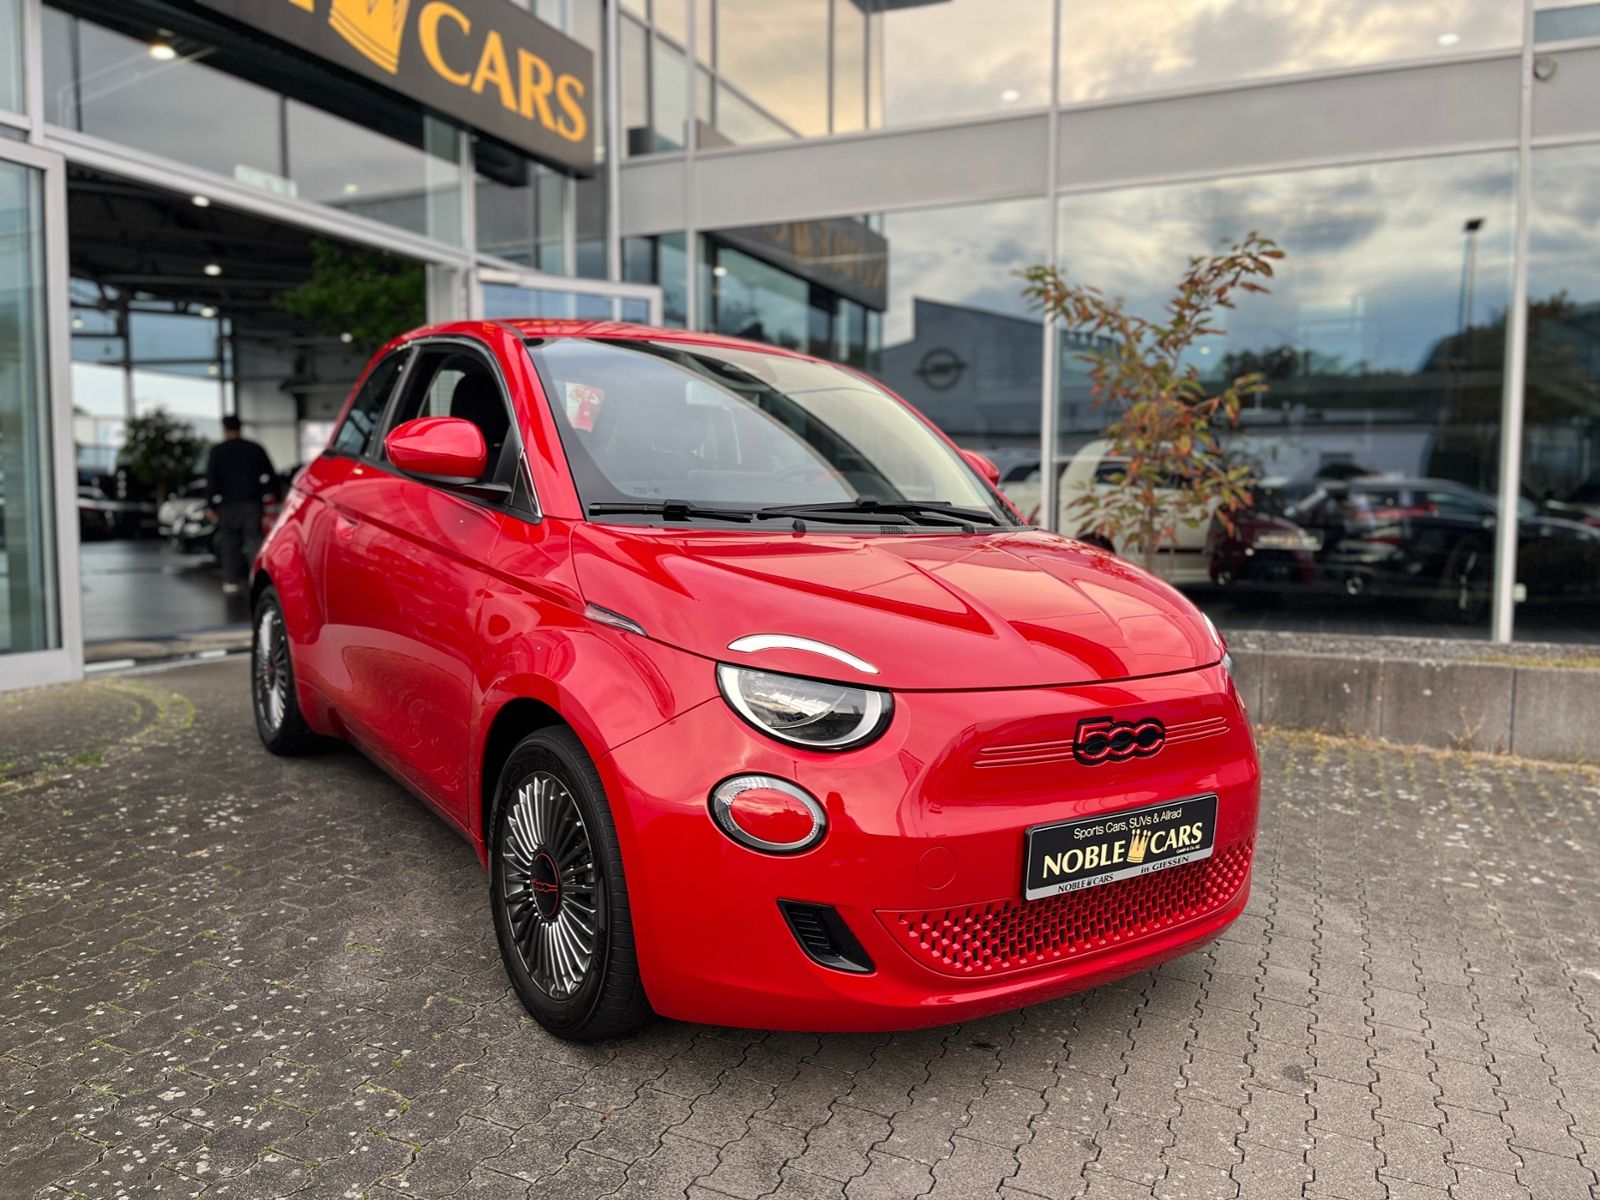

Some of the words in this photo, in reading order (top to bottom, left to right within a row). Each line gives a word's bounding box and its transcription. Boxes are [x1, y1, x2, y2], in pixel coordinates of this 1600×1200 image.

[418, 2, 587, 142] CARS
[1073, 716, 1166, 767] 500
[1074, 825, 1104, 840] Sports
[1105, 820, 1128, 834] Cars,
[1129, 815, 1152, 829] SUVs
[1153, 812, 1160, 824] &
[1160, 808, 1182, 822] Allrad
[1042, 840, 1126, 878] NOBLE
[1150, 822, 1203, 854] CARS
[1057, 879, 1087, 893] NOBLE
[1092, 873, 1114, 886] CARS
[1140, 866, 1150, 874] in
[1152, 855, 1190, 871] GIESSEN
